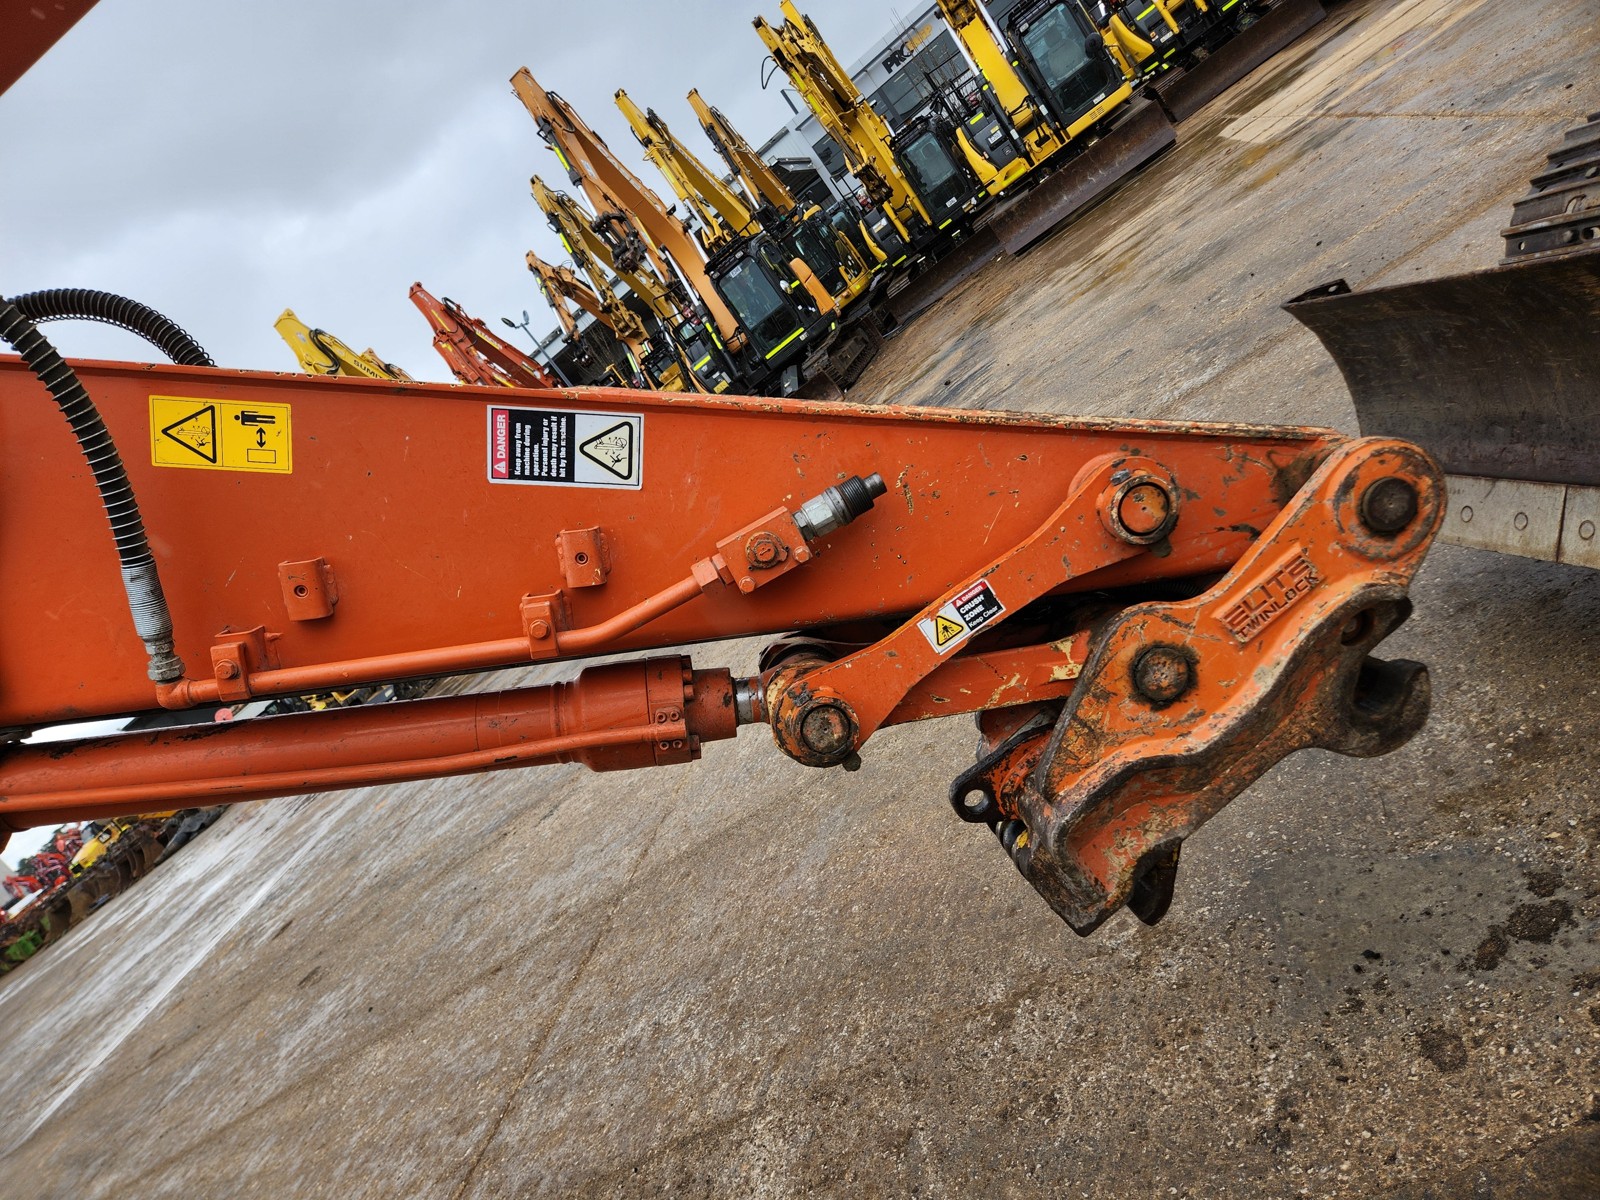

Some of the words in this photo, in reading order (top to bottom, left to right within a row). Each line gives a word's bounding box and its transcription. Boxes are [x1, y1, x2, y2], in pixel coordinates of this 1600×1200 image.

[542, 417, 549, 426] or
[496, 414, 506, 459] DANGER
[523, 424, 532, 447] during
[541, 426, 550, 447] injury
[550, 422, 558, 443] result
[515, 439, 523, 458] away
[532, 442, 540, 476] operation.
[514, 458, 522, 476] Keep
[559, 458, 567, 468] by
[961, 585, 984, 602] DANGER
[1222, 555, 1310, 629] ELITE
[960, 594, 985, 614] CRUSH
[963, 604, 985, 621] ZONE
[1236, 571, 1320, 638] TWINLOCK
[968, 616, 984, 628] Keep
[983, 605, 998, 618] Clear
